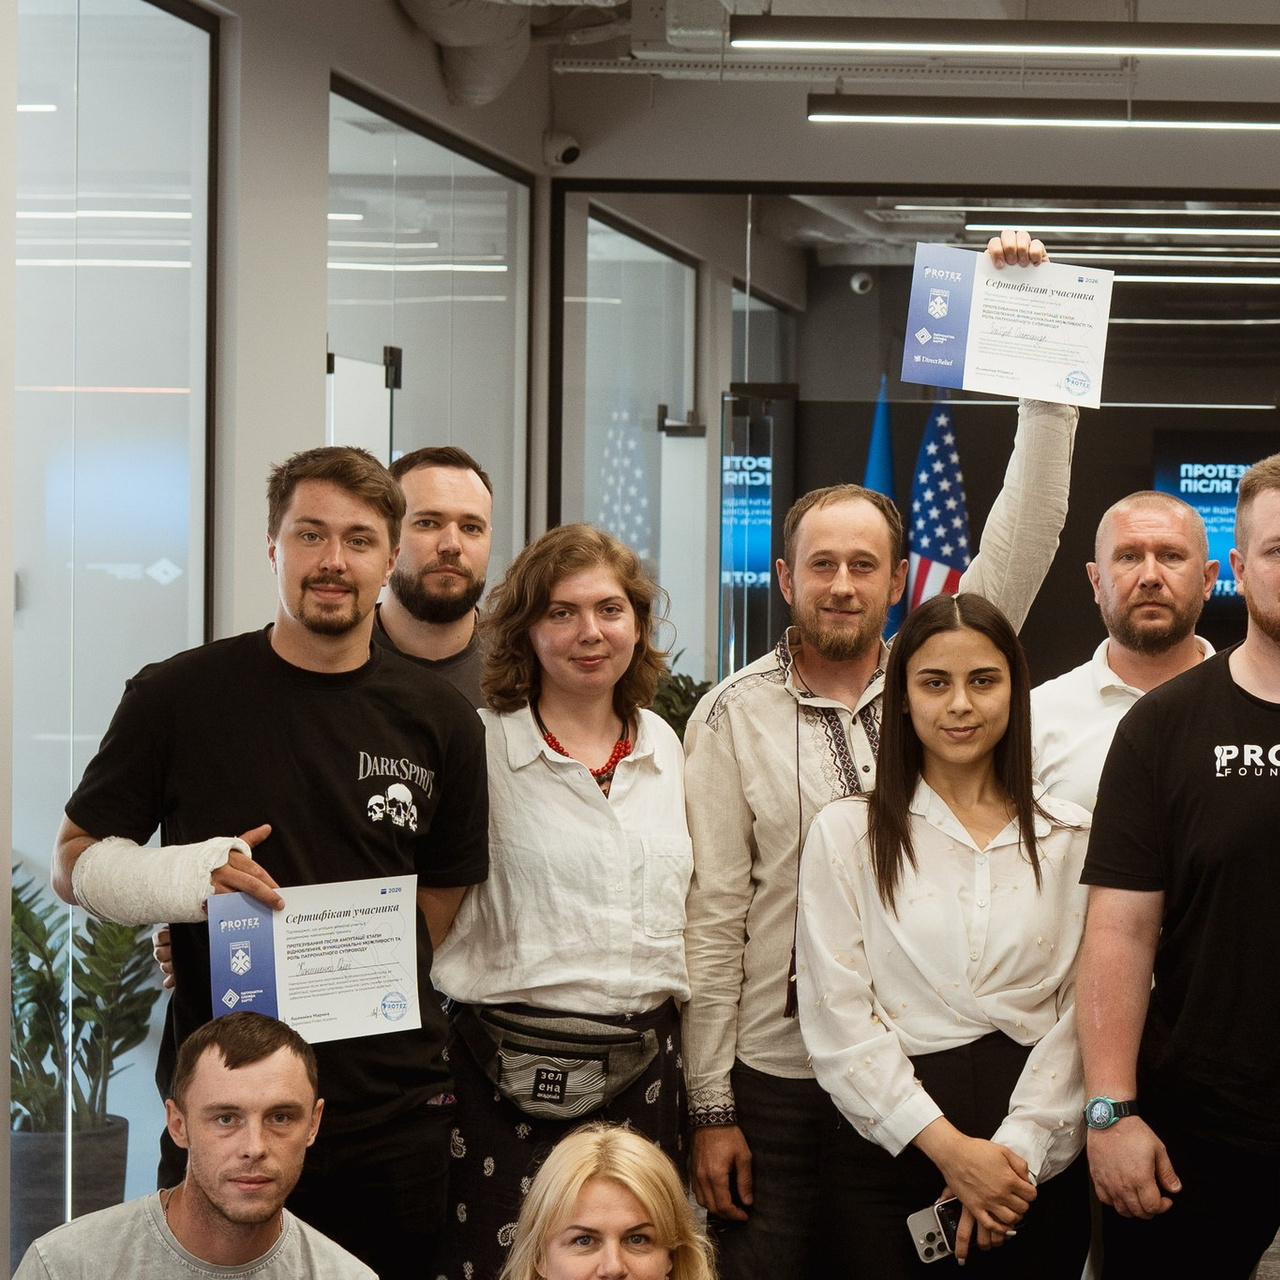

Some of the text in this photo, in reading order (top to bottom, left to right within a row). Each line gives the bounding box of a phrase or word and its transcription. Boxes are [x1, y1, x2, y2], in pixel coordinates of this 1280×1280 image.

[924, 267, 961, 280] PROTEZ
[985, 279, 1094, 300] Сертифікат учасника
[1180, 464, 1250, 478] ПРОТЕЗ
[1180, 479, 1233, 493] ПІСЛЯ
[286, 904, 398, 924] Сертифікат учасника
[219, 917, 258, 929] PROTEZ
[540, 1071, 563, 1081] зел
[538, 1083, 561, 1093] ена
